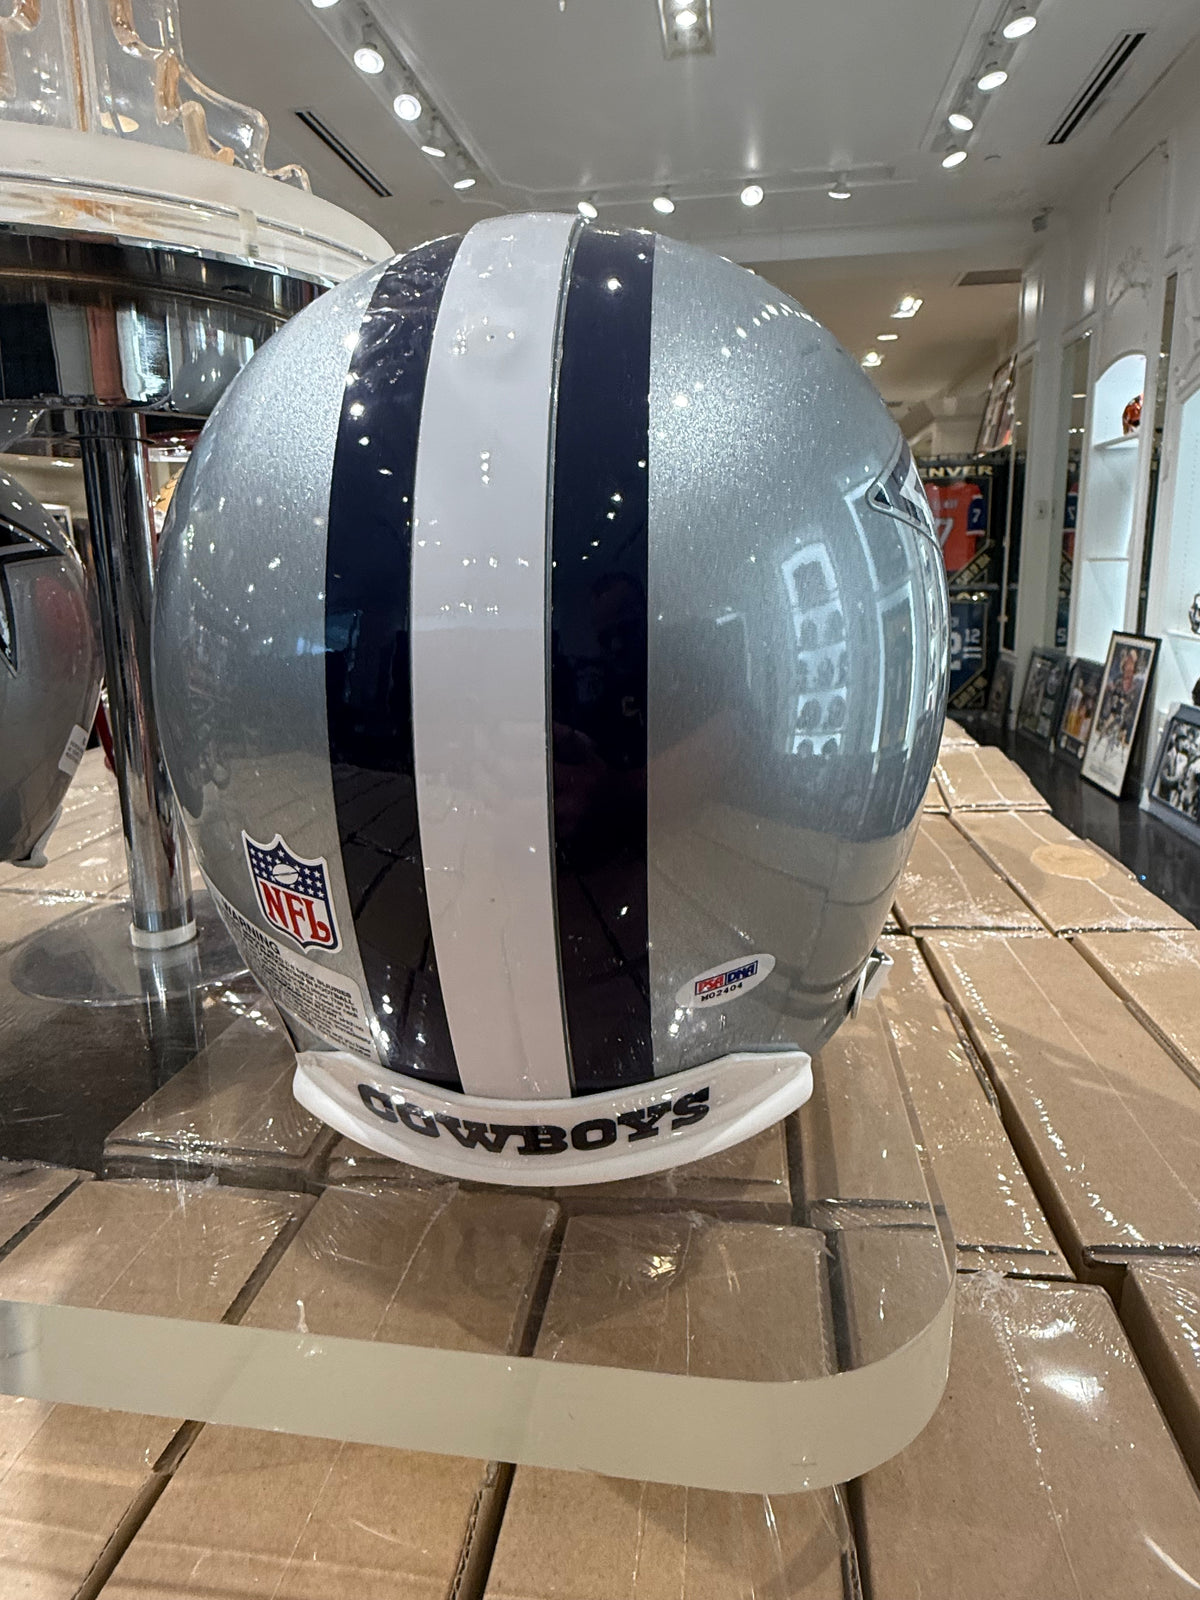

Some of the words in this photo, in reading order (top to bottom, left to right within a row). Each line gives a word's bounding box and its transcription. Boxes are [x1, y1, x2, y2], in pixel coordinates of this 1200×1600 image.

[919, 465, 993, 478] ENVER
[972, 509, 982, 523] 7
[965, 628, 981, 643] 12
[222, 898, 280, 955] WARNING
[260, 881, 331, 943] NFL
[358, 1083, 710, 1155] COWBOYS
